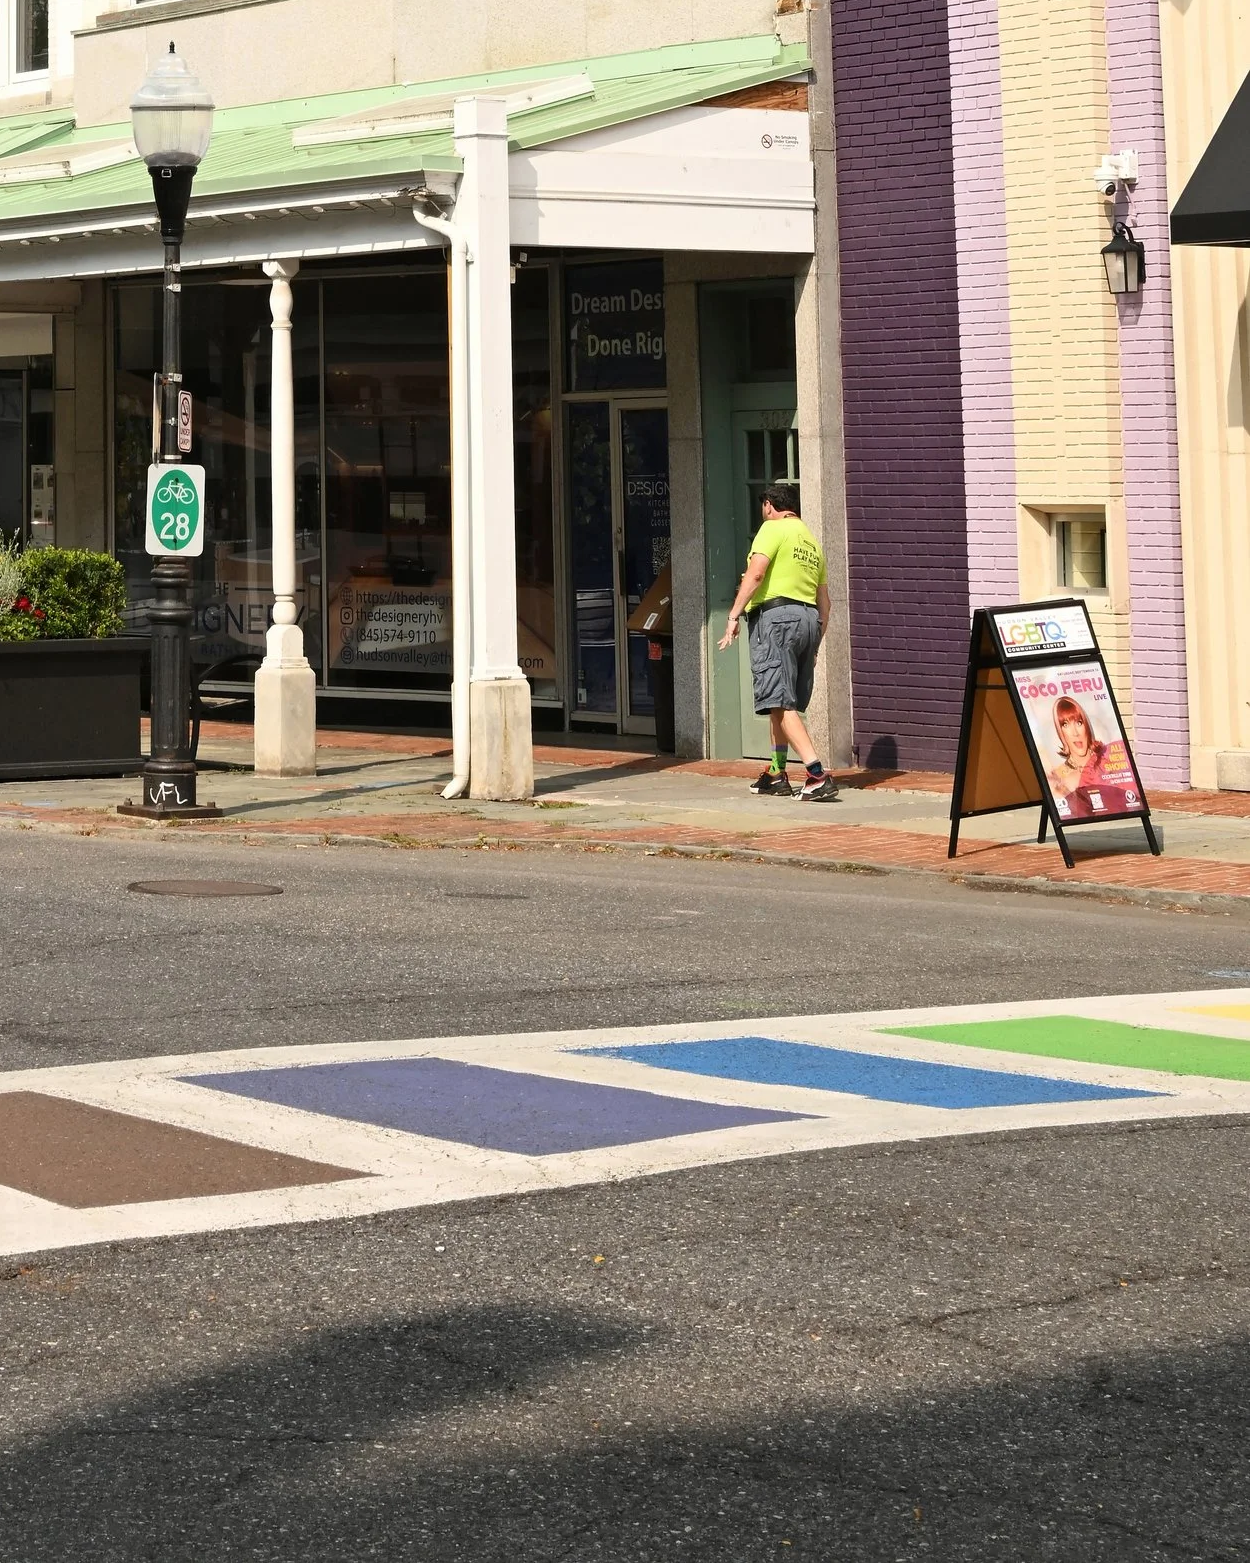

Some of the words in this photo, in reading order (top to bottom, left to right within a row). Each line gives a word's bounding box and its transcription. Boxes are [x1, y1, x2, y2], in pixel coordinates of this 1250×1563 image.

[571, 292, 626, 315] Dream
[587, 334, 631, 357] Done
[160, 512, 190, 540] 28
[356, 609, 443, 625] thedesigneryhv
[356, 628, 436, 644] (845)574-9110
[999, 621, 1067, 646] LGBTQ
[1007, 644, 1041, 653] COMMUNITY
[1042, 641, 1065, 650] CENTER
[1019, 682, 1058, 699] COCO
[1061, 677, 1103, 694] PERU
[1093, 693, 1108, 701] LIVE
[1110, 744, 1124, 753] ALL
[150, 782, 188, 804] VFL
